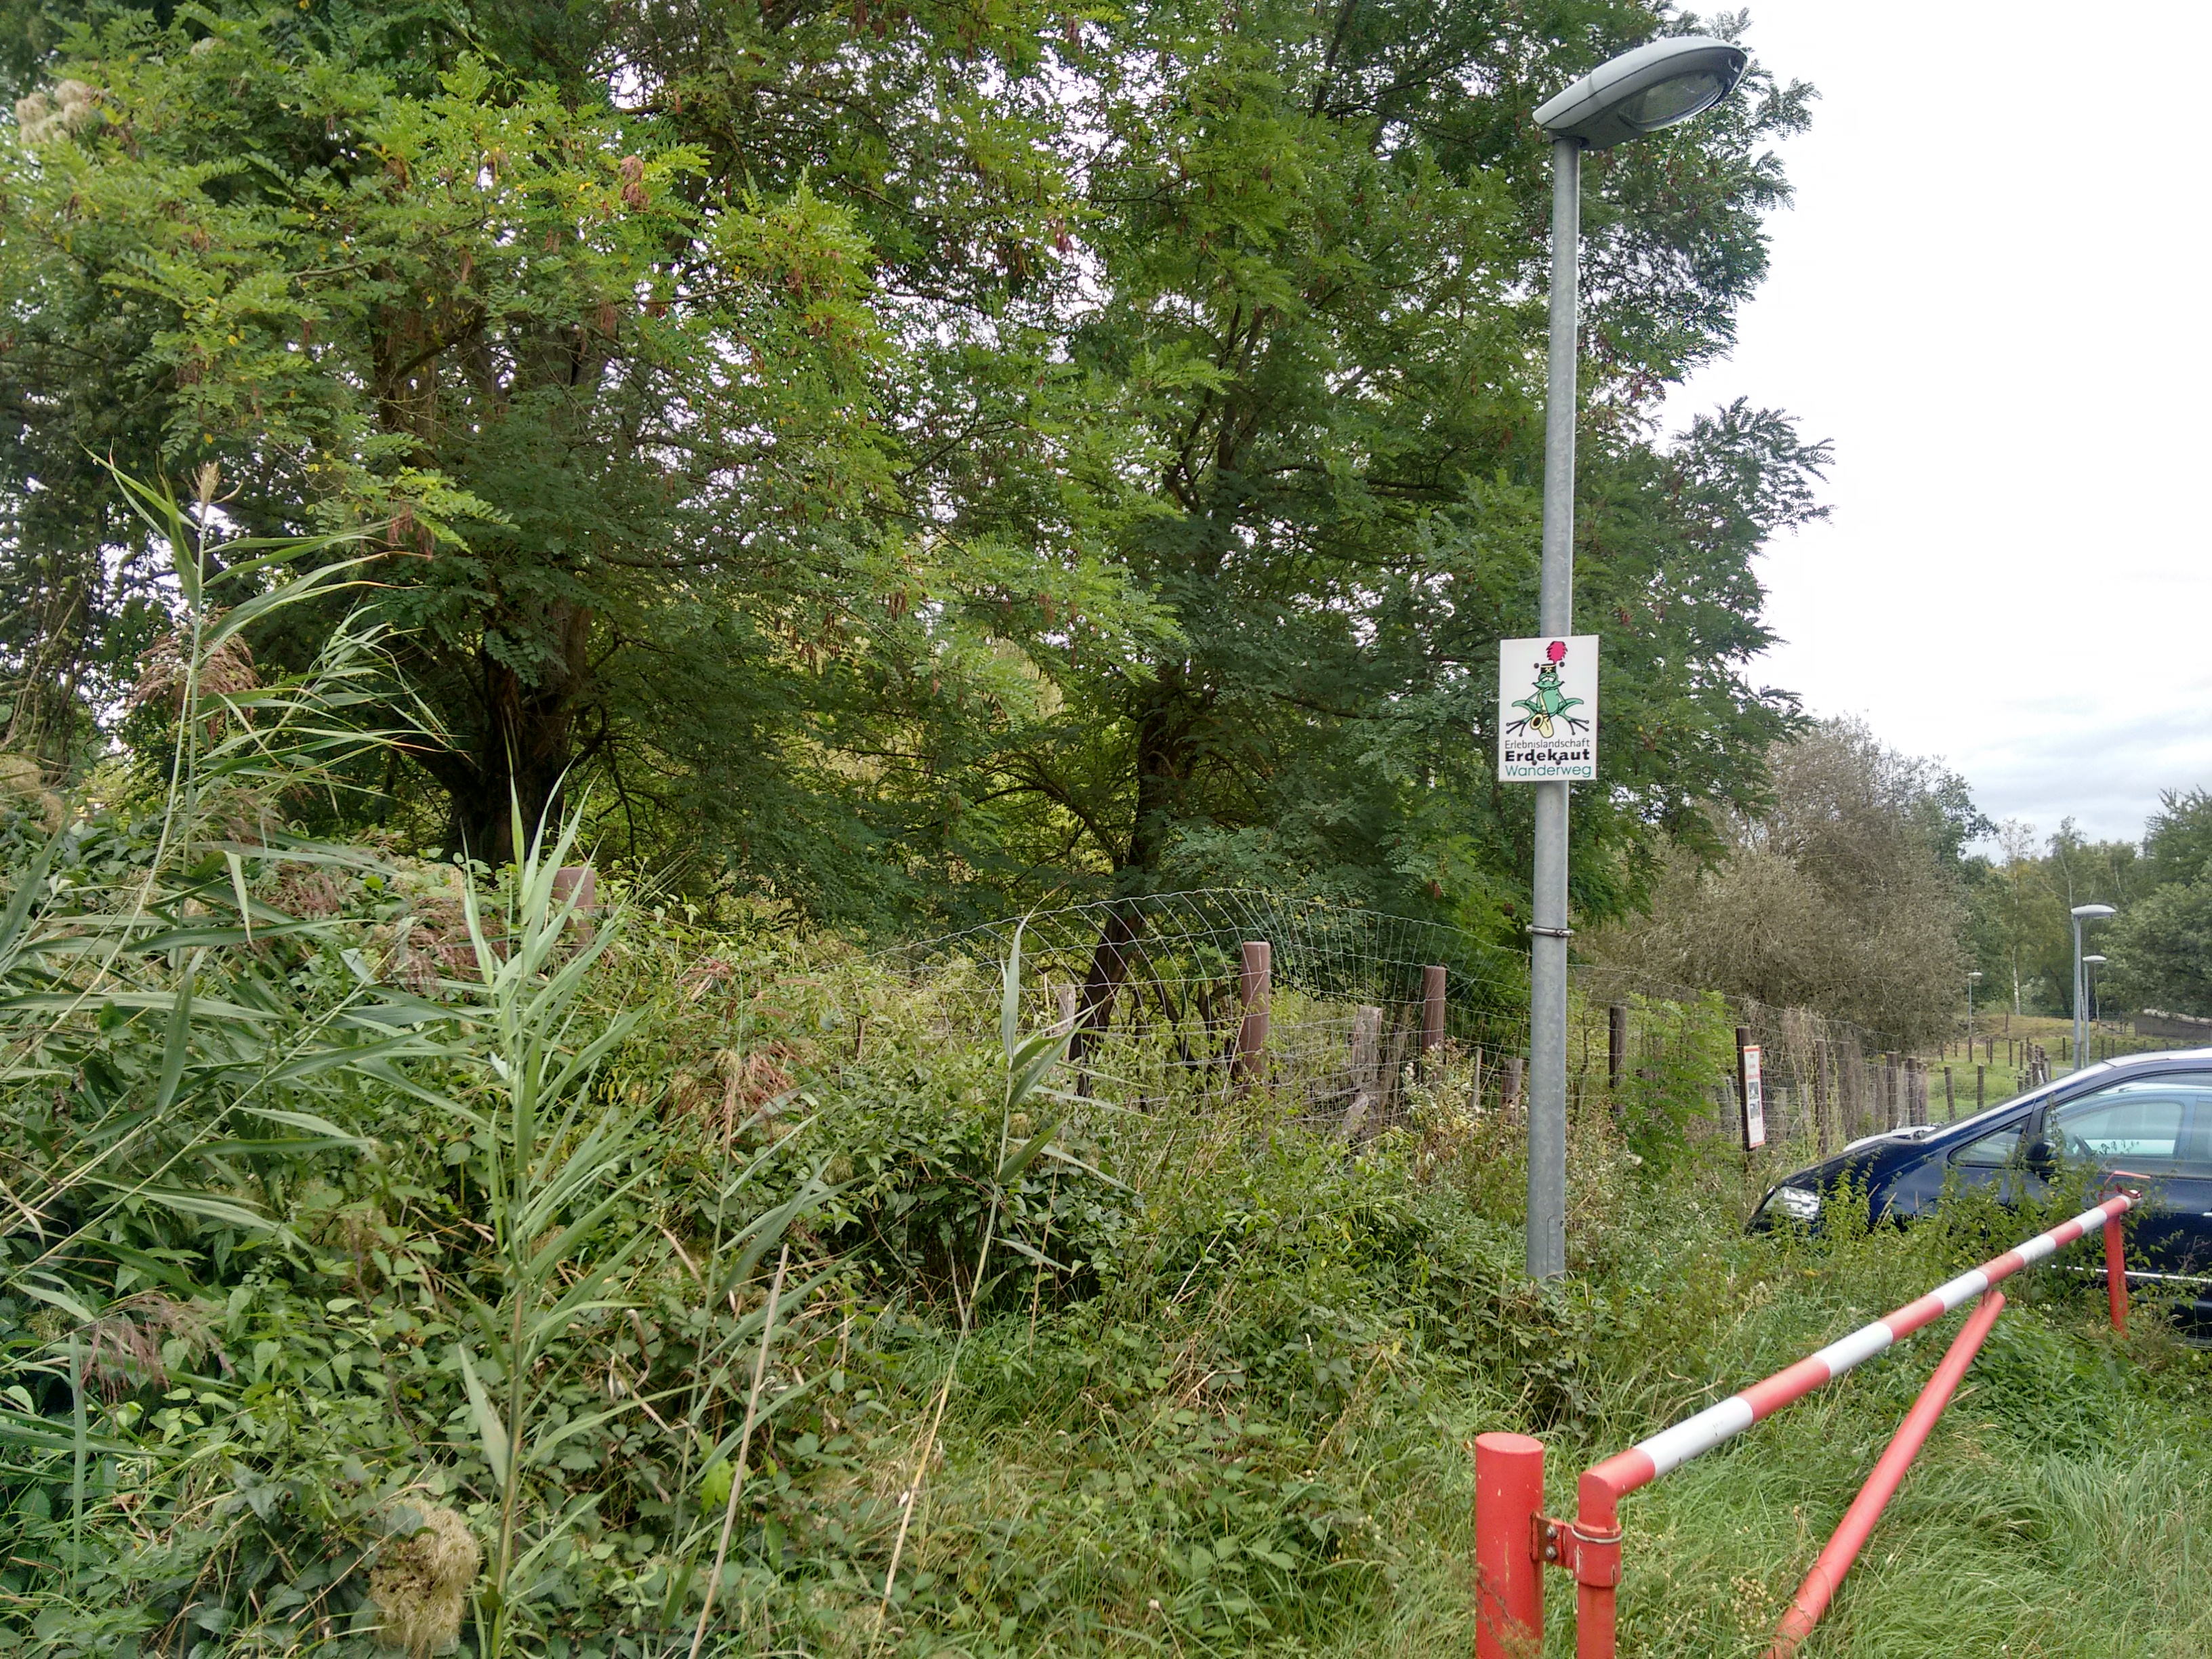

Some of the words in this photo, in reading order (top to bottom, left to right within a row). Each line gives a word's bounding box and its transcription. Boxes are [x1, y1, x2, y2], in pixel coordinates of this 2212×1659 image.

[1505, 738, 1590, 749] Erlebnislandschaft
[1505, 749, 1590, 762] Erdekaut
[1505, 764, 1591, 778] Wanderweg
